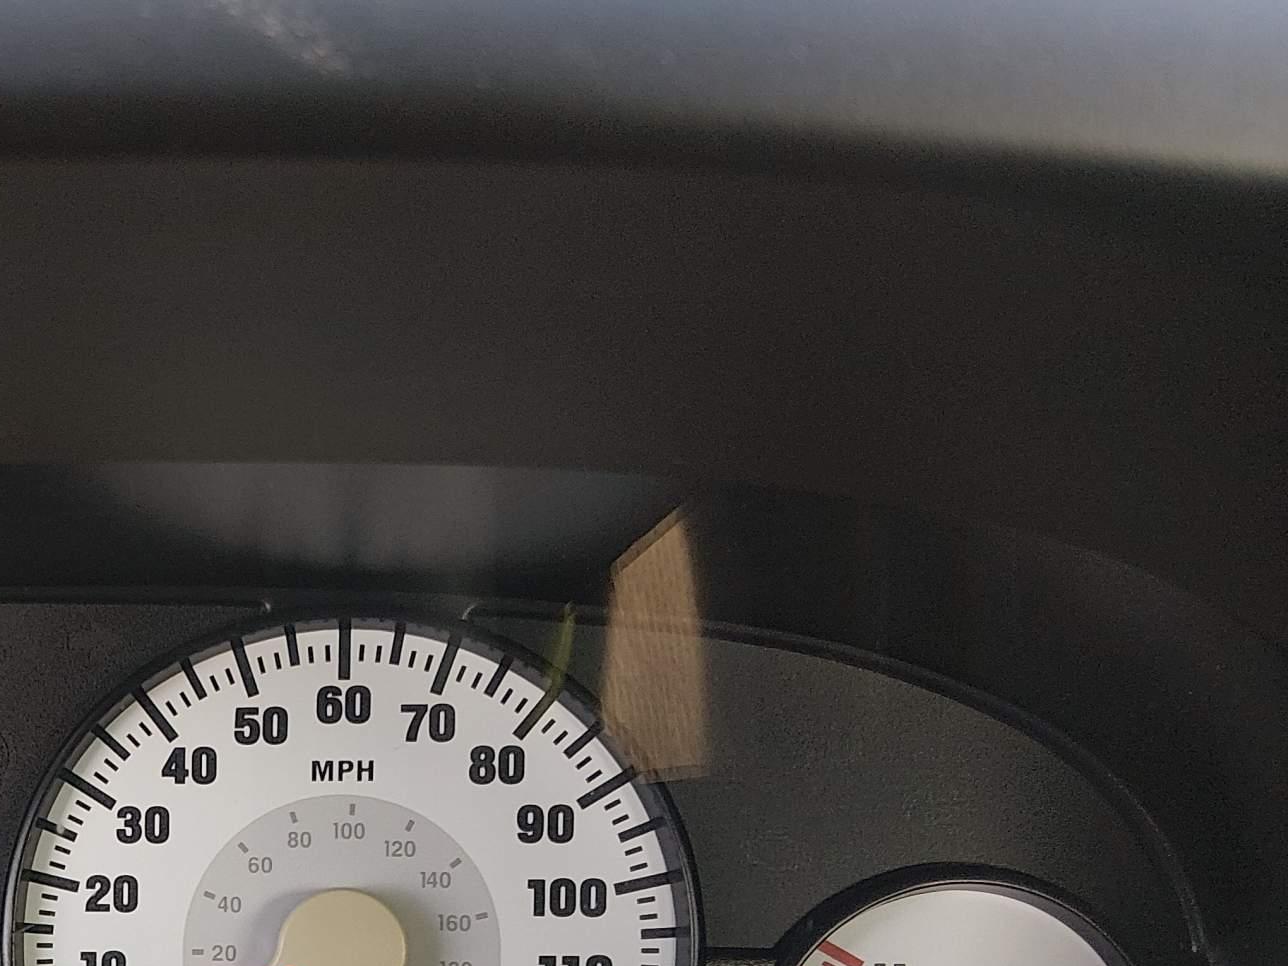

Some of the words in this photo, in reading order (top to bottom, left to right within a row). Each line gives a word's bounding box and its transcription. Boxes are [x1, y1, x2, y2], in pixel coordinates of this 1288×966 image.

[316, 685, 372, 724] 60
[233, 706, 289, 745] 50
[400, 703, 456, 743] 70
[161, 746, 218, 785] 40
[311, 760, 375, 782] MPH
[468, 745, 526, 785] 80
[115, 805, 171, 844] 30
[332, 822, 366, 840] 100
[516, 804, 575, 844] 90
[287, 831, 312, 848] 80
[383, 839, 417, 858] 120
[247, 856, 273, 874] 60
[419, 871, 452, 889] 140
[84, 874, 139, 913] 20
[217, 895, 242, 914] 40
[526, 877, 608, 918] 100
[437, 914, 472, 932] 160
[211, 944, 237, 962] 20
